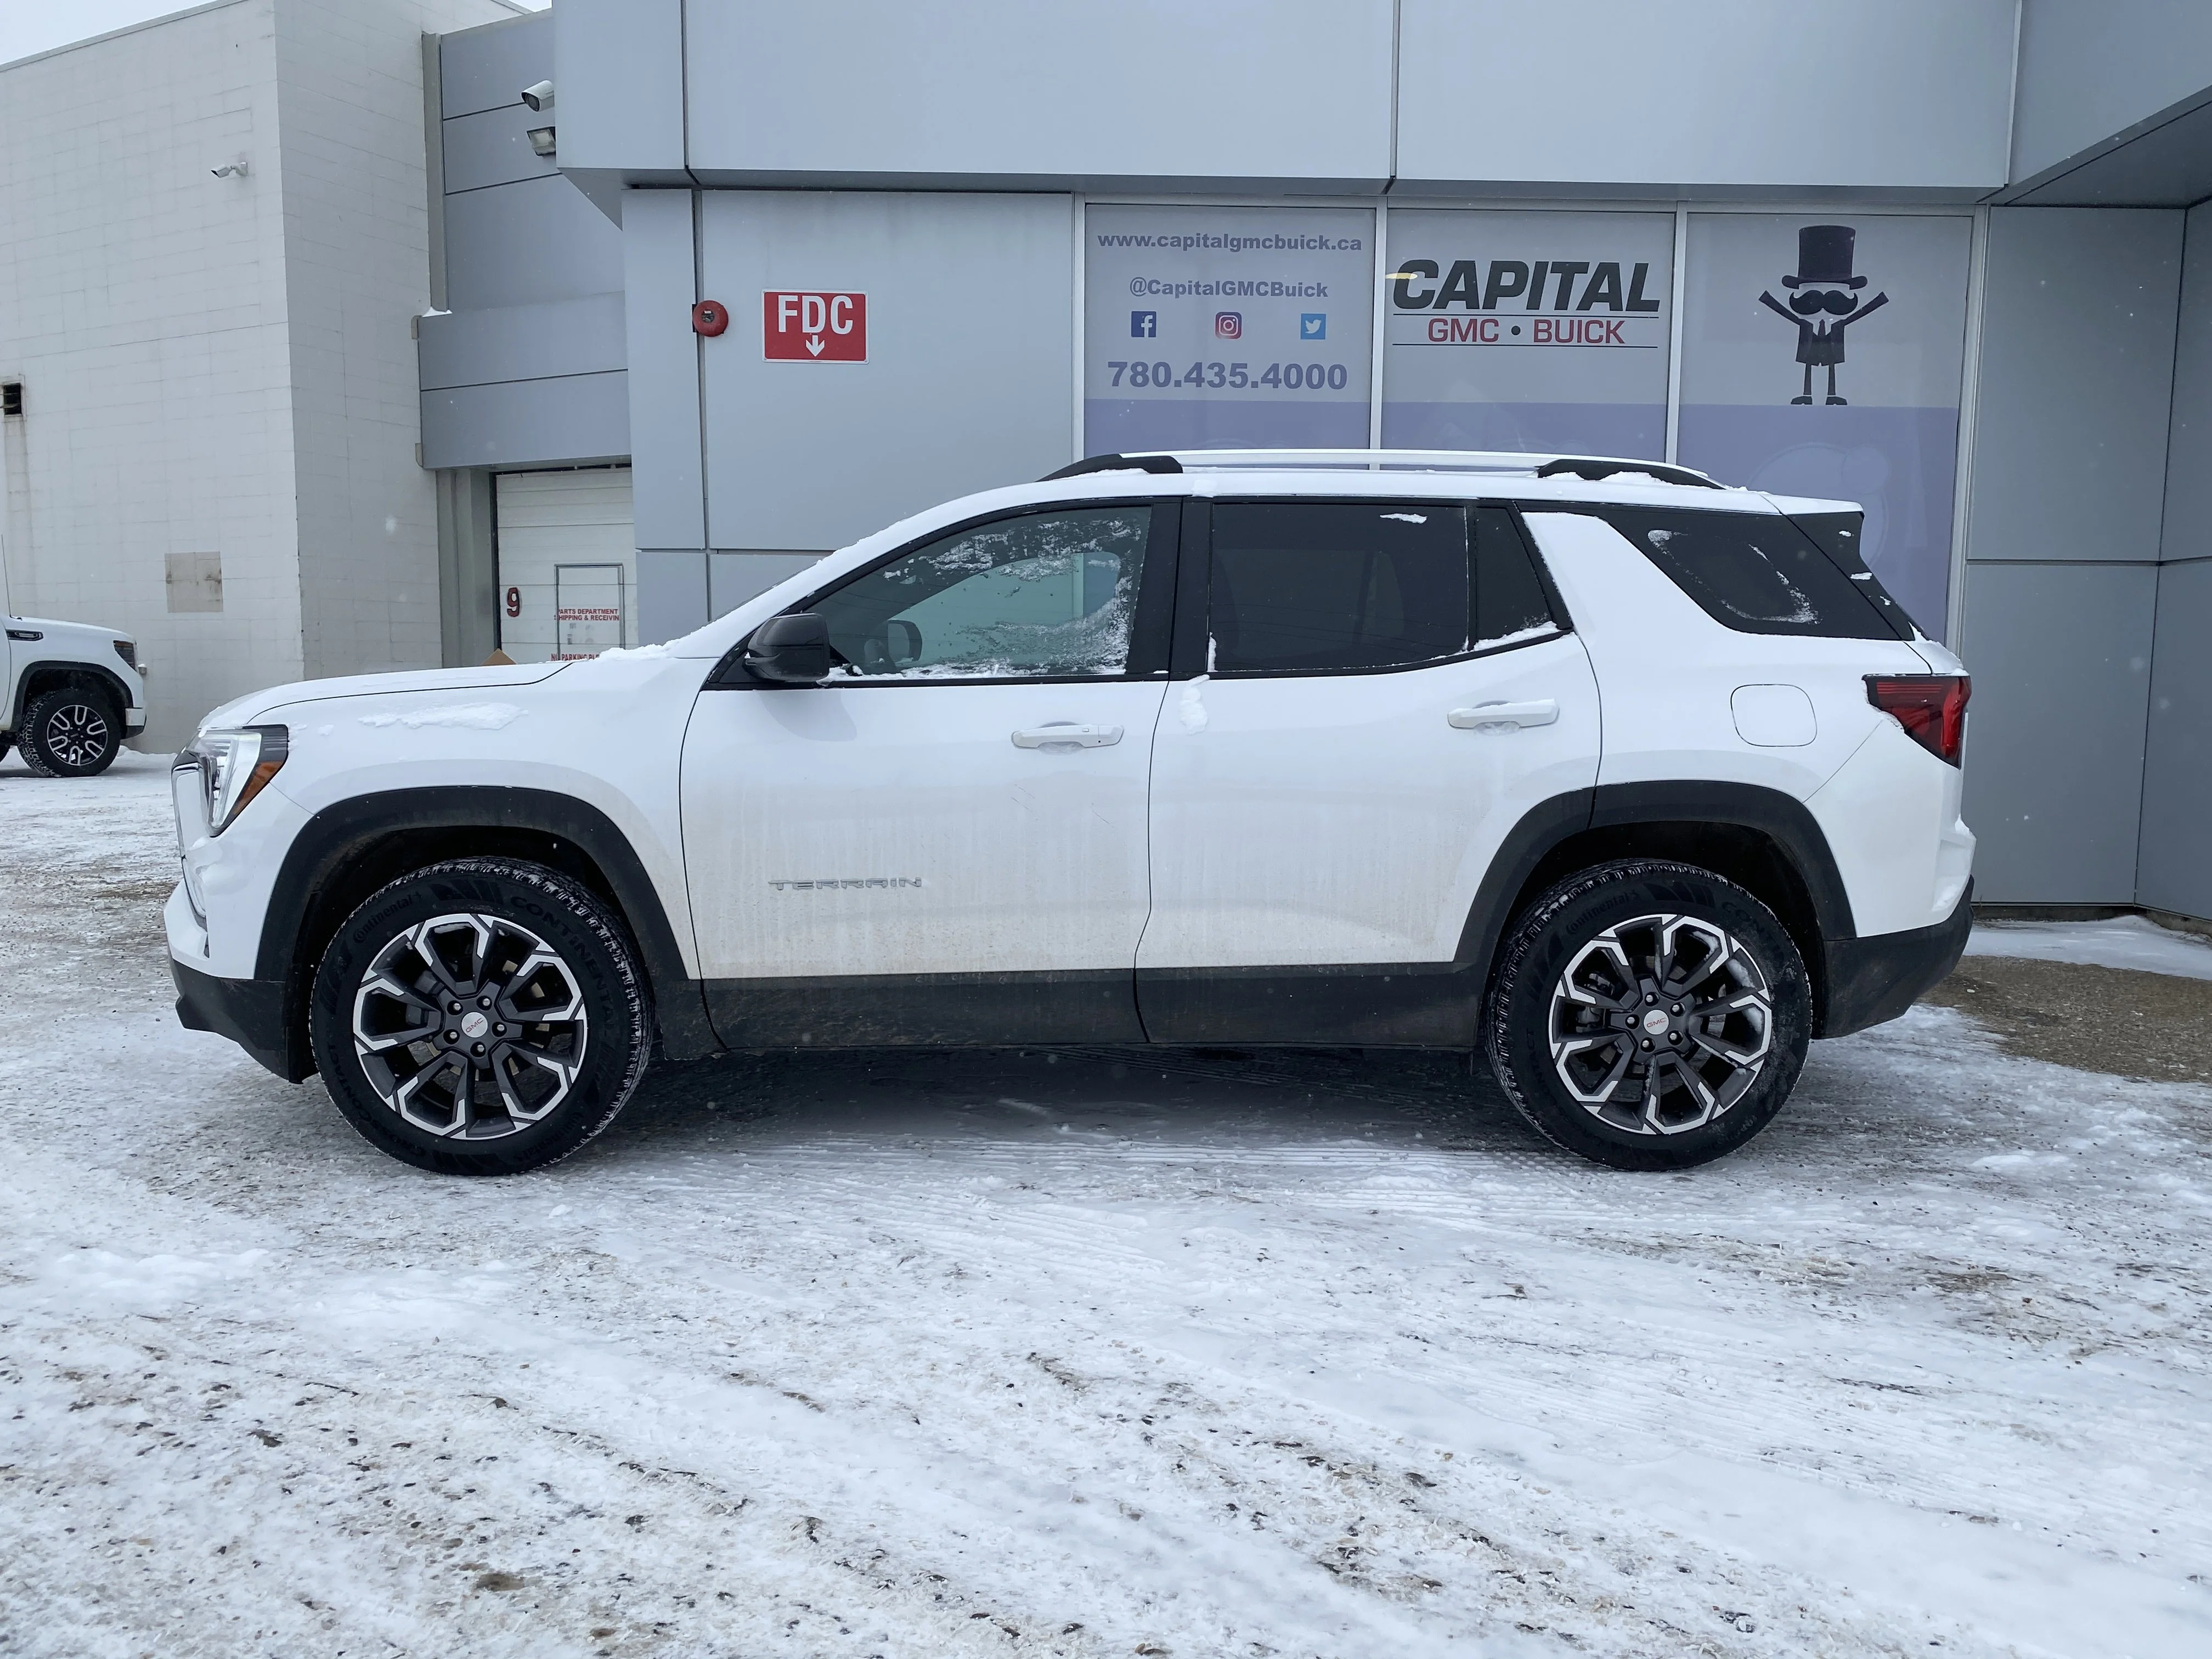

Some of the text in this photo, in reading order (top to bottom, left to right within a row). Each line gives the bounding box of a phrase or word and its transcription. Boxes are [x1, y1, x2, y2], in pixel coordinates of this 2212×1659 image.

[1097, 233, 1362, 252] www.capitalgmcbuick.ca
[1129, 276, 1329, 298] @CapitalGMCBuick
[1393, 259, 1661, 312] CAPITAL
[777, 295, 854, 335] FDC
[1428, 318, 1626, 344] GMC BUICK
[1107, 361, 1348, 390] 780.435.4000
[506, 586, 520, 618] 9
[768, 877, 922, 891] TERRAIN
[352, 894, 415, 945] Continental
[510, 896, 613, 1036] CONTINENTAL
[466, 1017, 484, 1032] GMC
[1646, 1017, 1667, 1028] GMC
